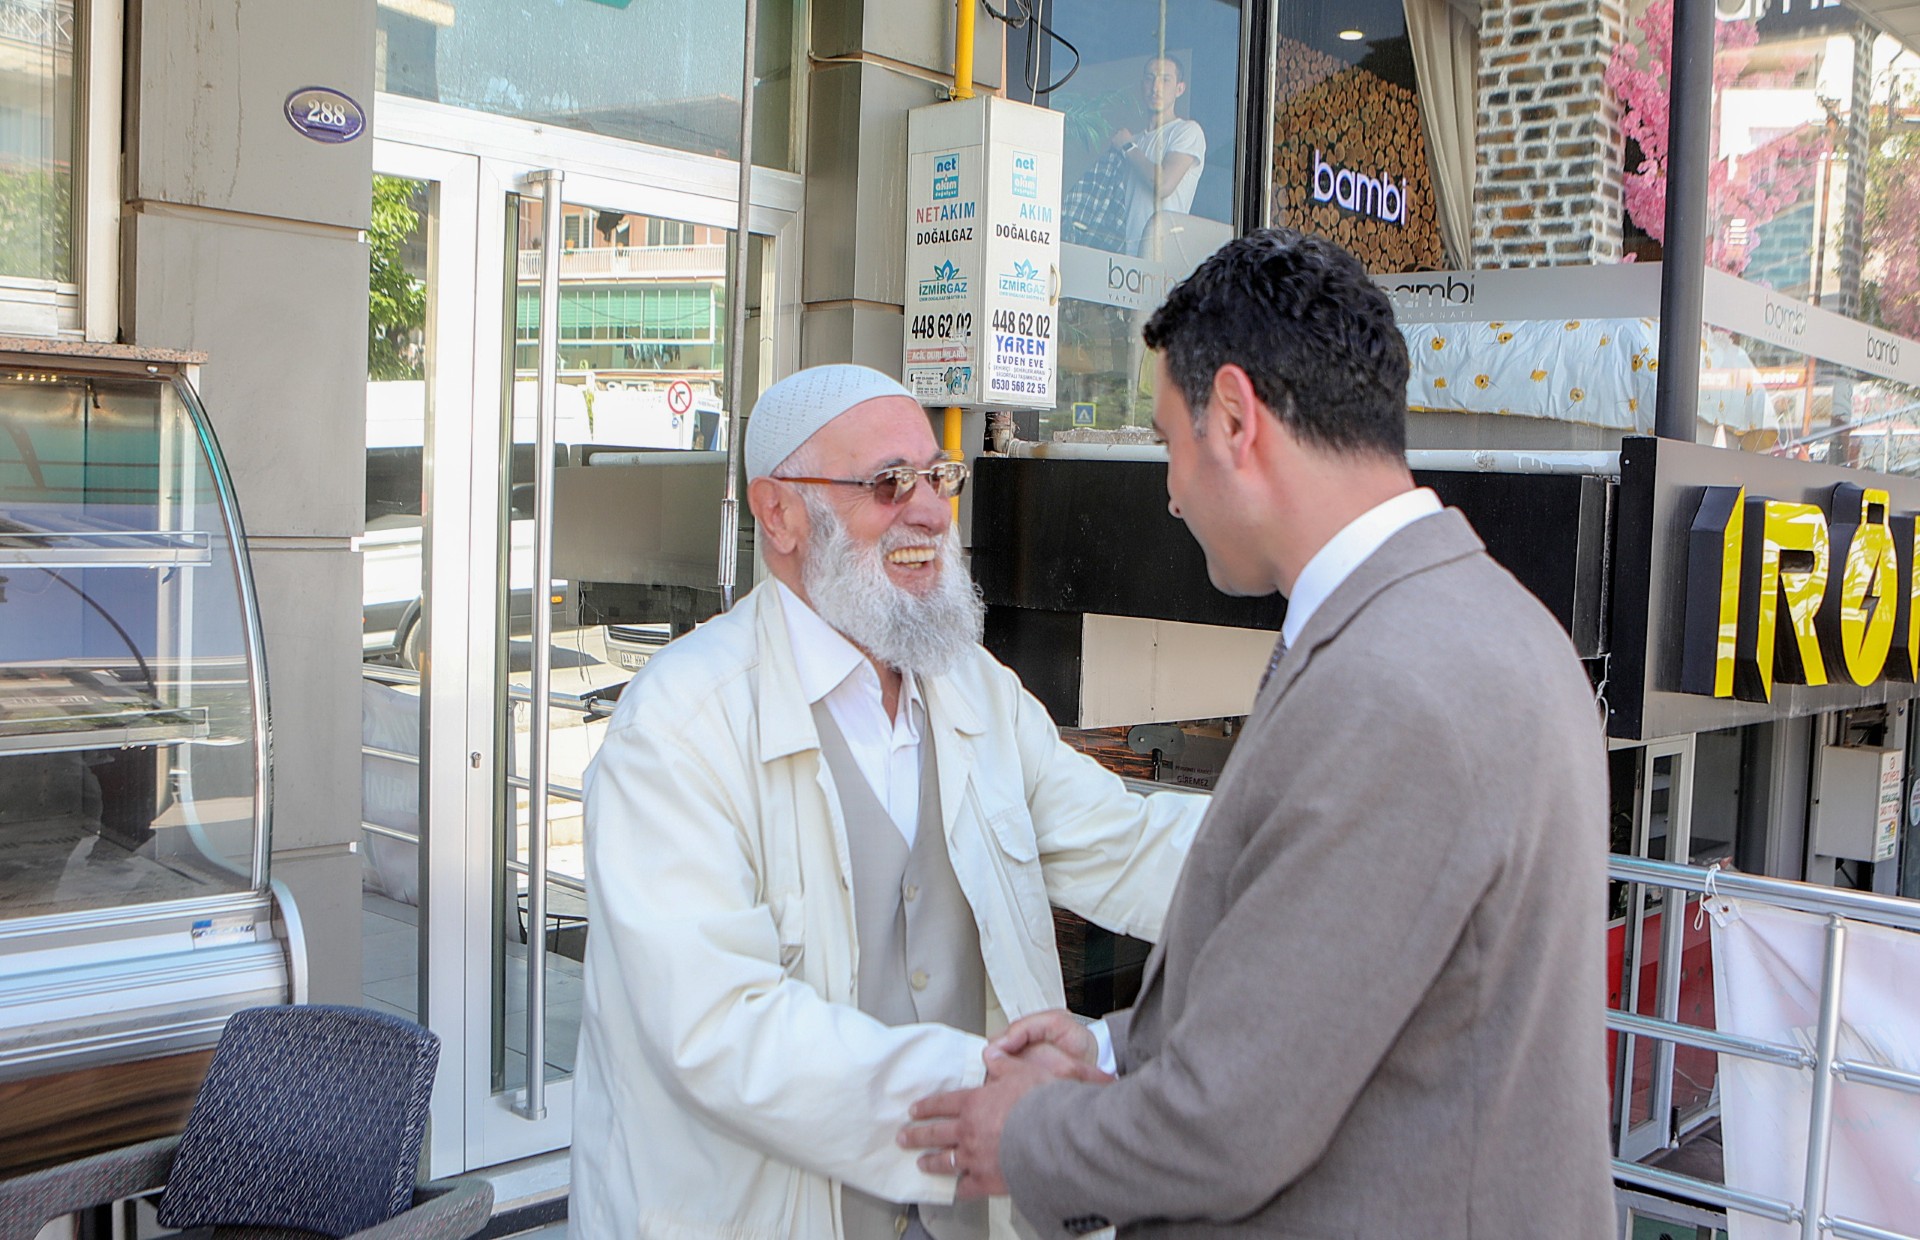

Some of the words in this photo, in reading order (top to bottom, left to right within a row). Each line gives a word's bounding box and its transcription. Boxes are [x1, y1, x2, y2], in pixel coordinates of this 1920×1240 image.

[307, 99, 346, 127] 288
[936, 157, 957, 173] net
[1015, 157, 1035, 171] net
[1313, 148, 1407, 226] bambi
[1019, 202, 1052, 223] AKIM
[916, 227, 973, 245] DOĞALGAZ
[996, 223, 1050, 245] DOĞALGAZ
[999, 276, 1046, 295] İZMİRGAZ
[1108, 256, 1180, 300] bamb
[919, 282, 967, 296] İZMİRGAZ
[992, 308, 1015, 334] 448
[1018, 312, 1033, 336] 62
[1036, 314, 1050, 339] 02
[1764, 293, 1808, 336] bambi
[911, 314, 935, 339] 448
[938, 313, 953, 338] 62
[995, 334, 1045, 356] YAREN
[996, 354, 1026, 366] EVDEN
[1029, 358, 1044, 369] EVE
[991, 378, 1010, 391] 0530
[1011, 380, 1025, 392] 568
[1026, 382, 1036, 394] 22
[1037, 383, 1046, 395] 55
[1692, 481, 1920, 704] IRO
[1176, 774, 1209, 787] GİREMEZ
